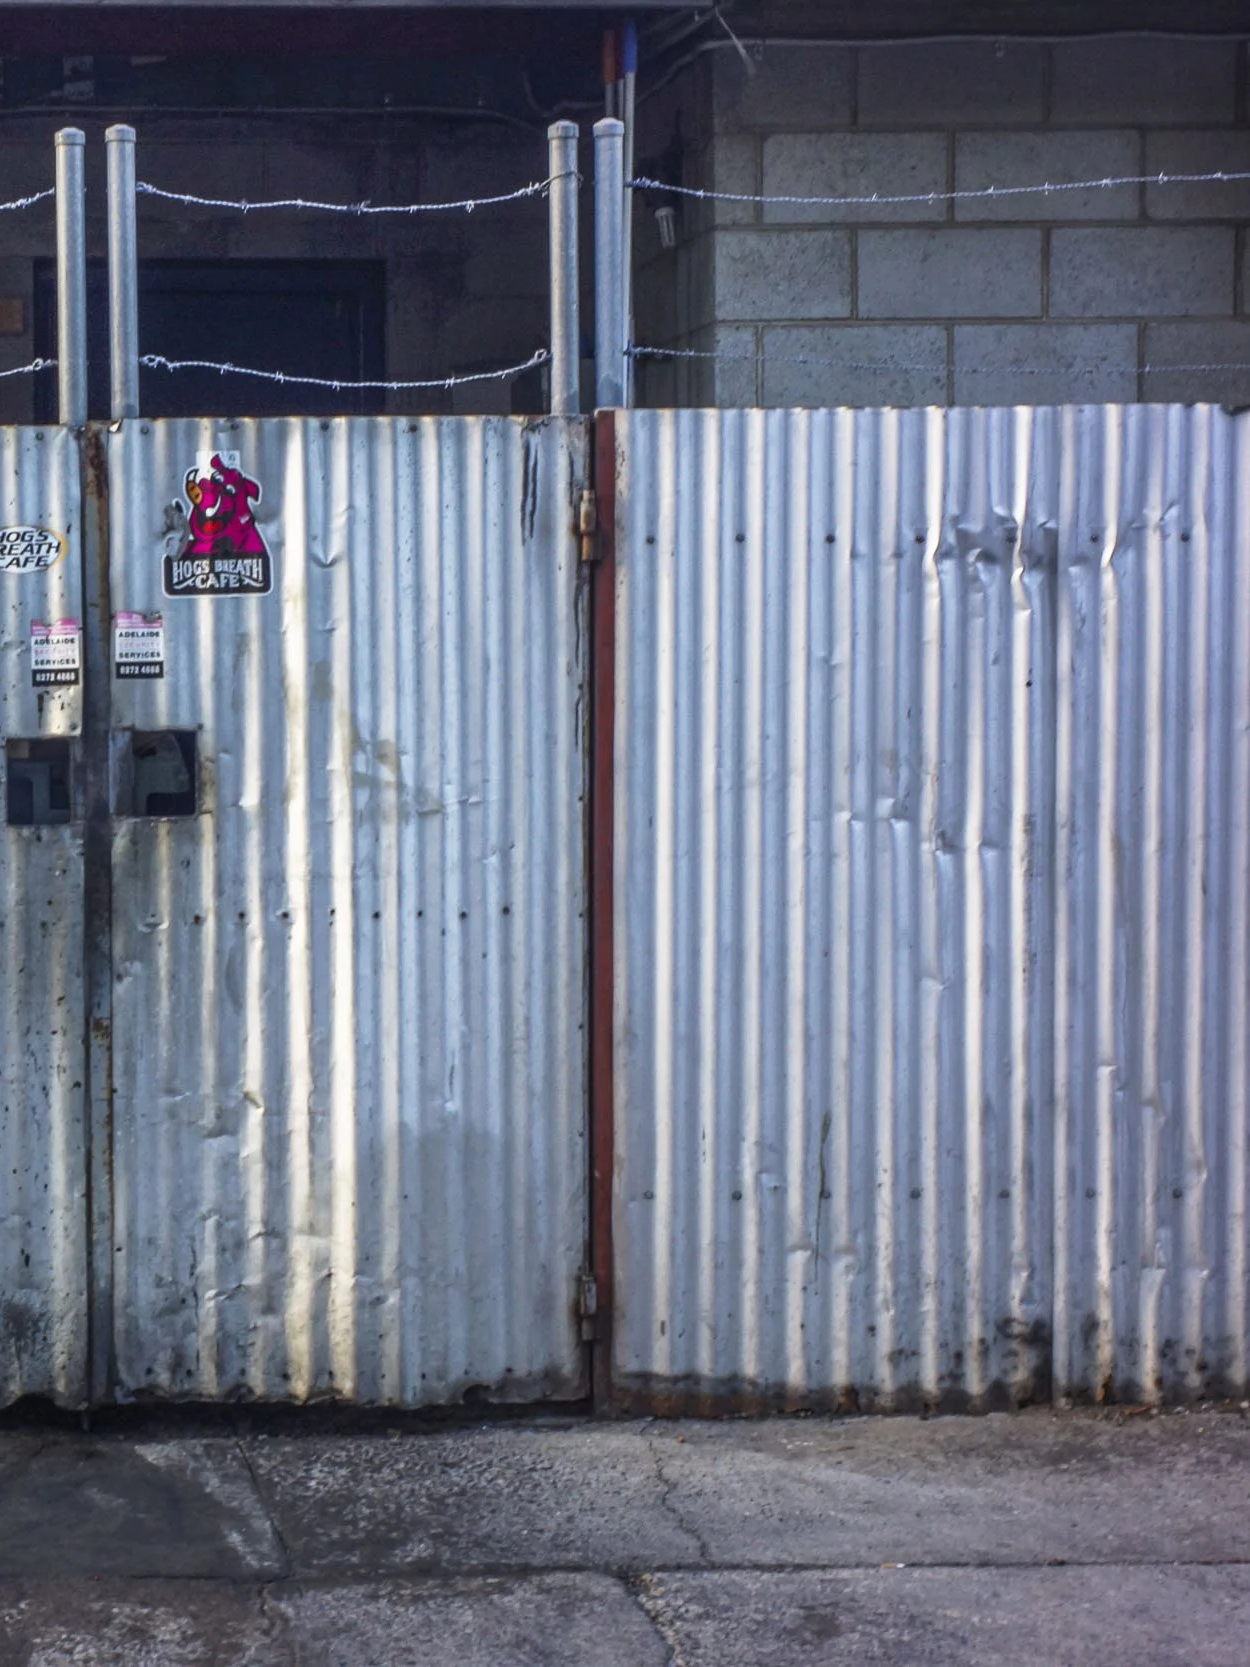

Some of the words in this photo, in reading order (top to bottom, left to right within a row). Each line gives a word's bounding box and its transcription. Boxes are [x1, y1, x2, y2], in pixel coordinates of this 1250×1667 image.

[213, 557, 263, 582] BREATH
[195, 573, 240, 589] CAFE
[34, 637, 76, 646] ADELAIDE
[118, 651, 161, 659] SERVICES
[34, 658, 76, 666] SERVICES
